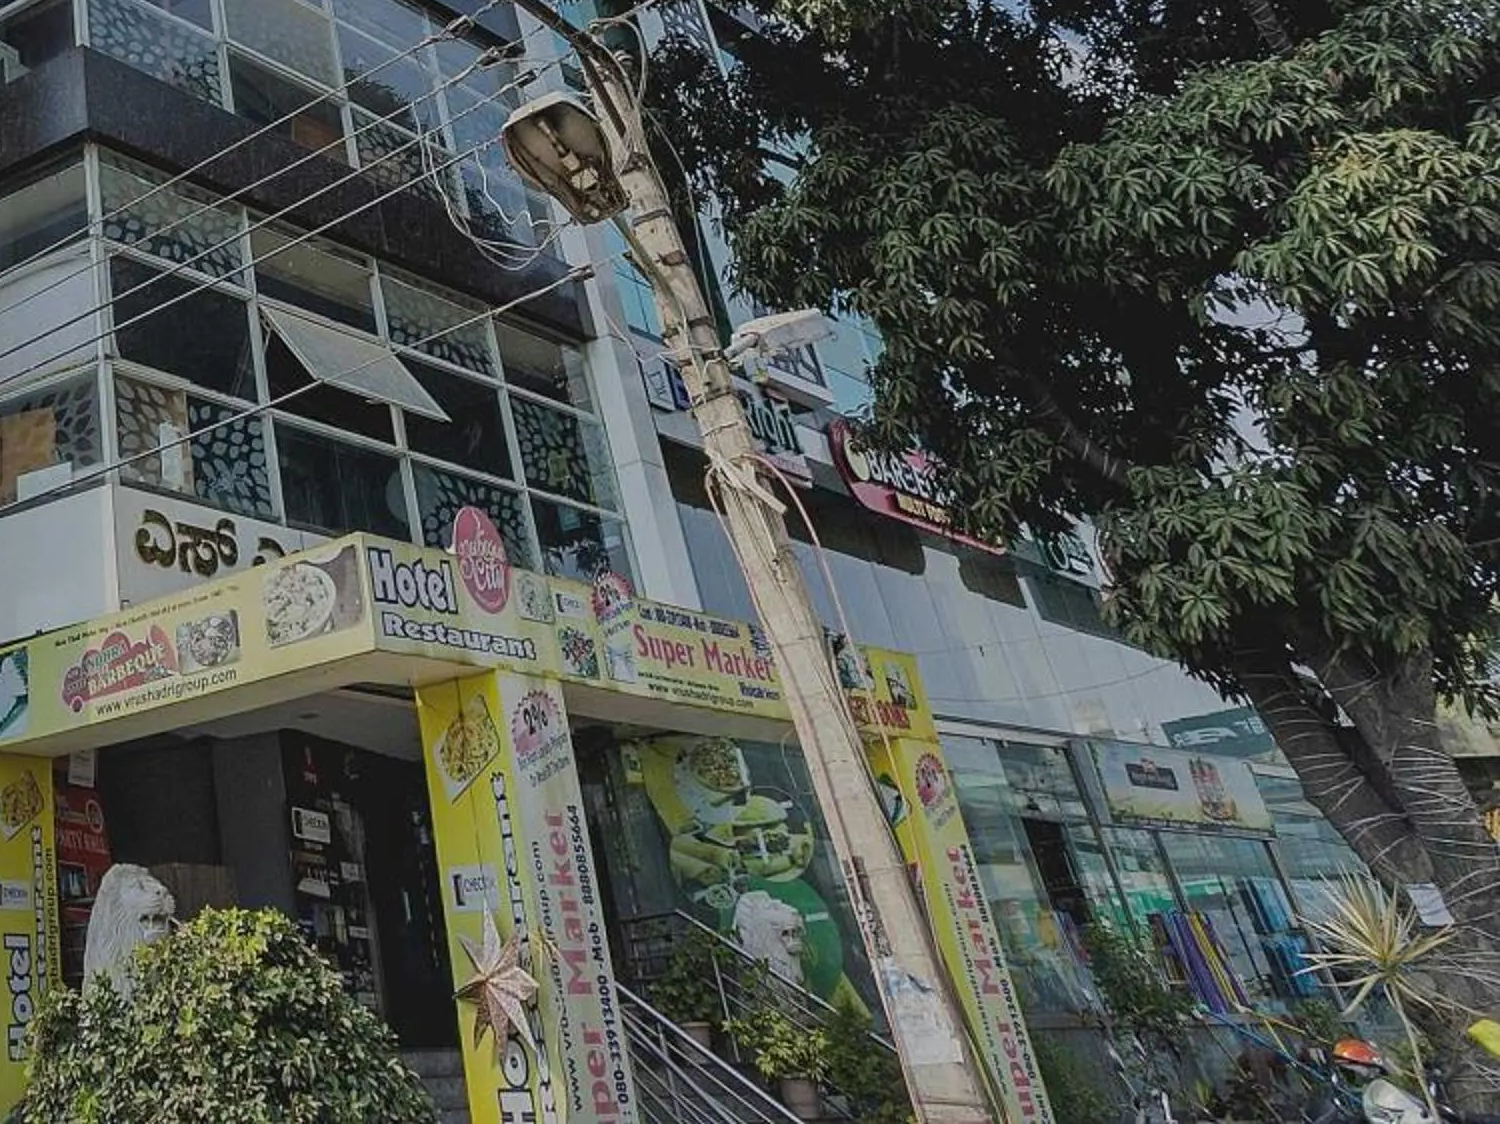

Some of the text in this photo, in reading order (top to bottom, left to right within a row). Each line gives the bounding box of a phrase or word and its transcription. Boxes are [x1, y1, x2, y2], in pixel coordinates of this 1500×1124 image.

[368, 547, 459, 614] Hotel
[382, 612, 537, 660] Restaurant
[632, 623, 695, 669] Super
[701, 637, 776, 683] Market
[545, 808, 593, 995] Market
[4, 933, 34, 1062] Hotel
